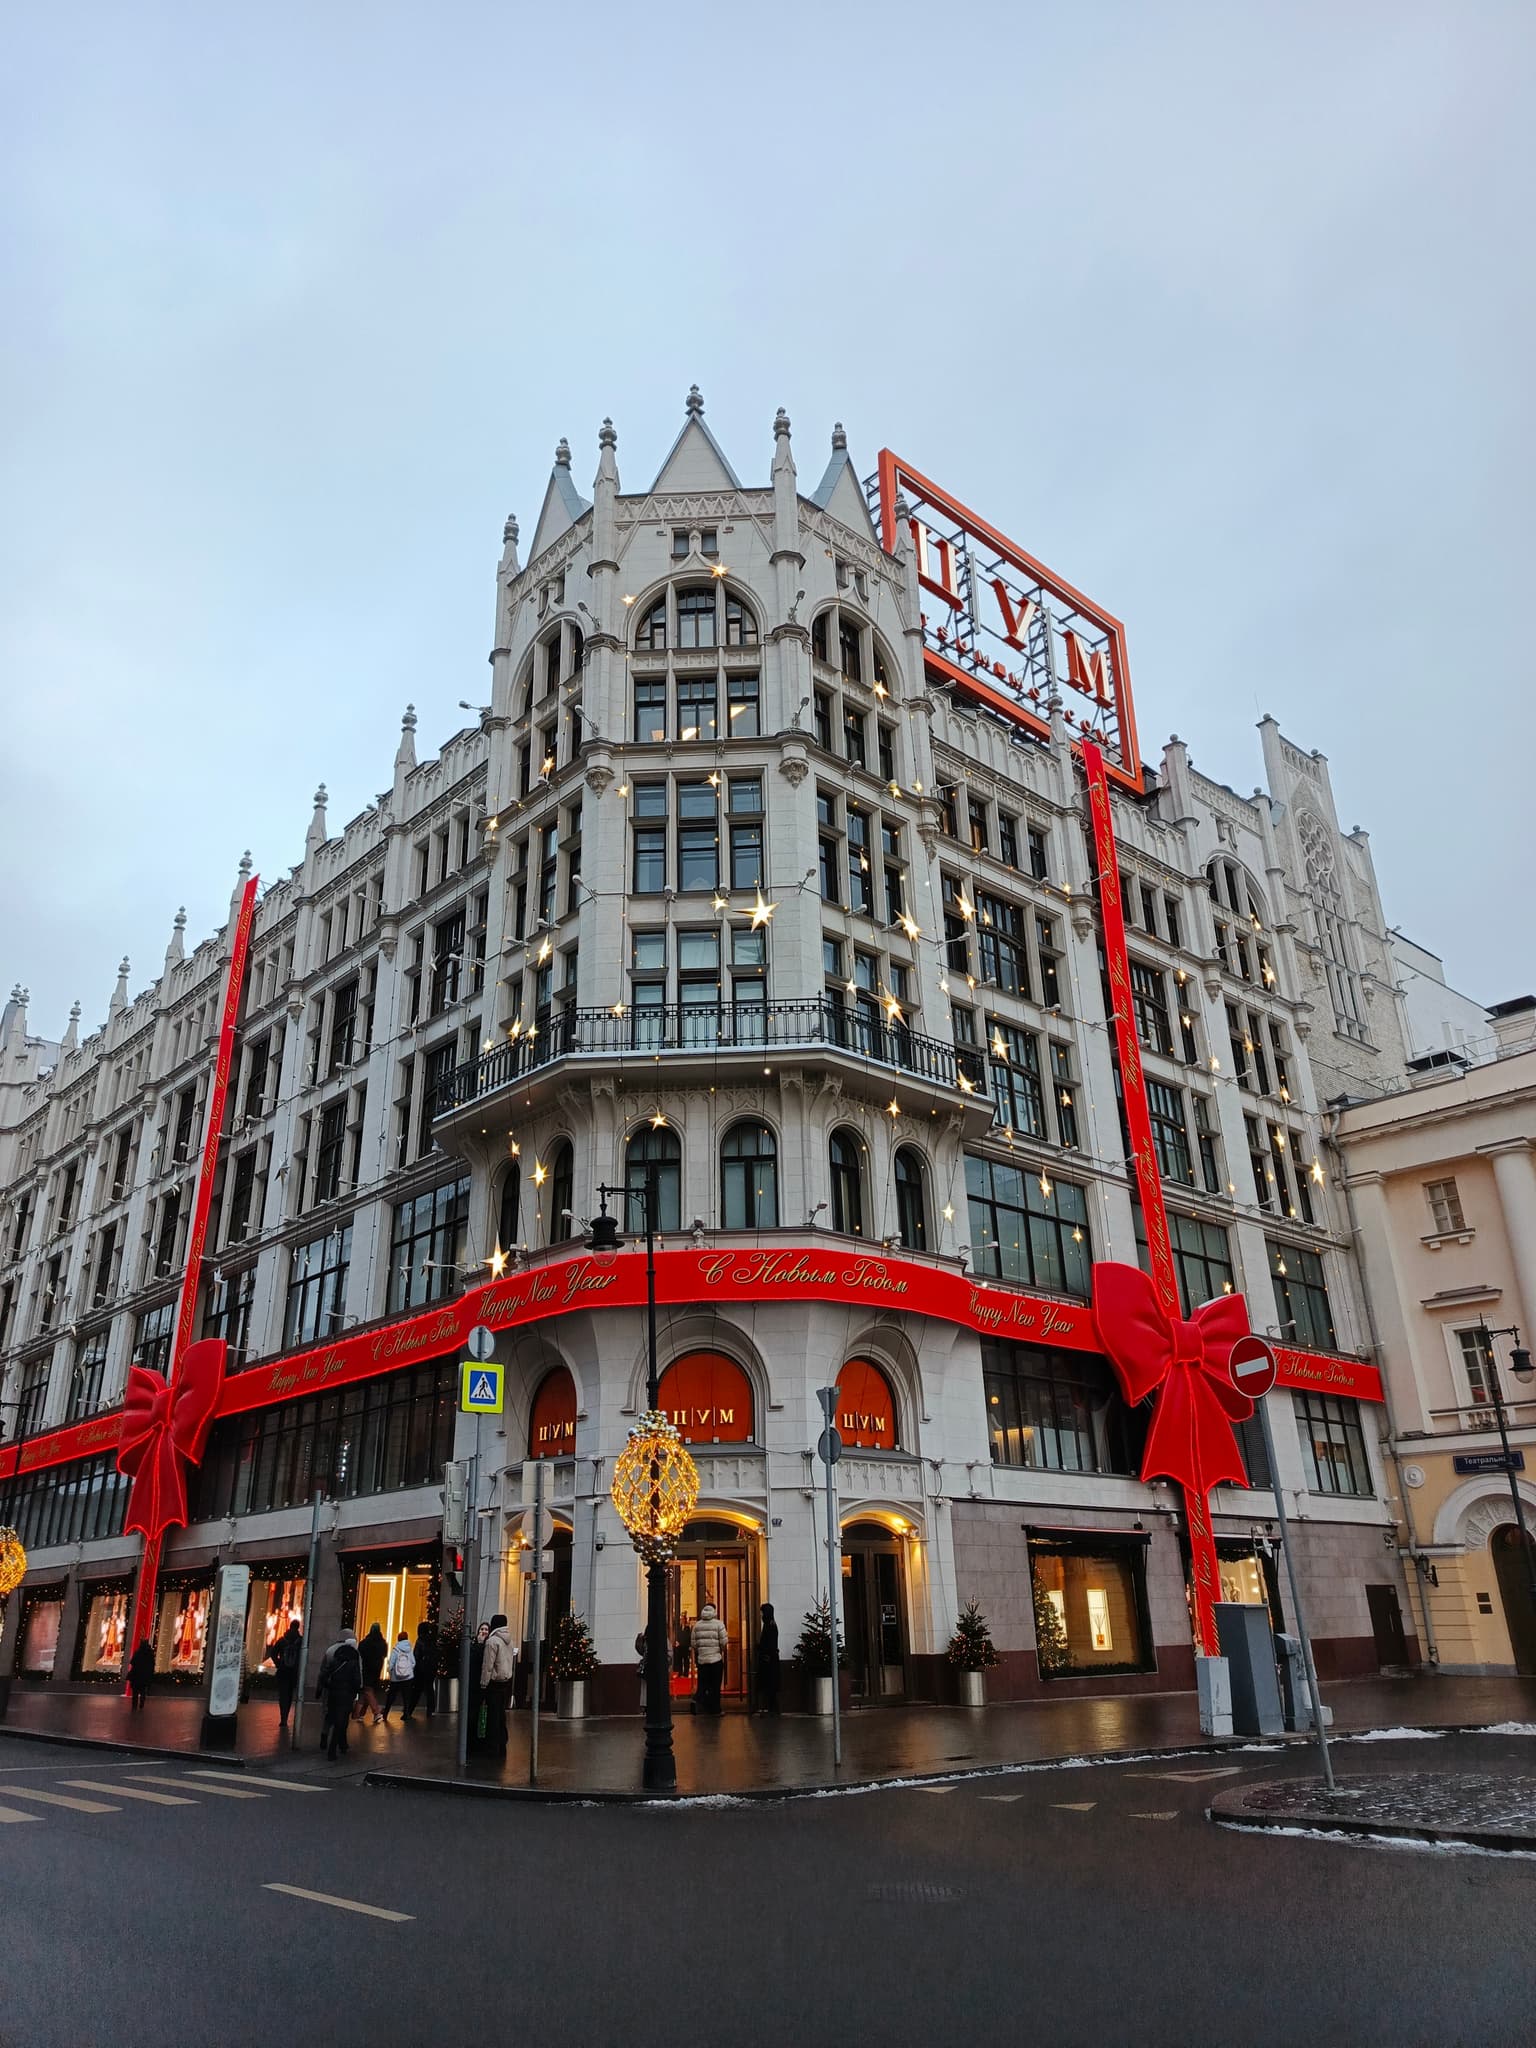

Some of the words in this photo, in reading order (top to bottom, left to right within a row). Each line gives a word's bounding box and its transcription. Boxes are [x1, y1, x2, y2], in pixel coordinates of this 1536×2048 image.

[1008, 672, 1111, 746] MOCOW
[476, 1287, 521, 1324] Happy
[520, 1271, 558, 1306] New
[562, 1260, 617, 1303] Year
[698, 1253, 735, 1284] С
[732, 1252, 837, 1285] Новым
[841, 1258, 909, 1293] Годом
[968, 1287, 1003, 1328] Happy
[1003, 1299, 1036, 1327] New
[1040, 1304, 1075, 1337] Year
[320, 1349, 346, 1382] Year
[1283, 1352, 1323, 1380] Новым
[1324, 1361, 1356, 1387] Годом
